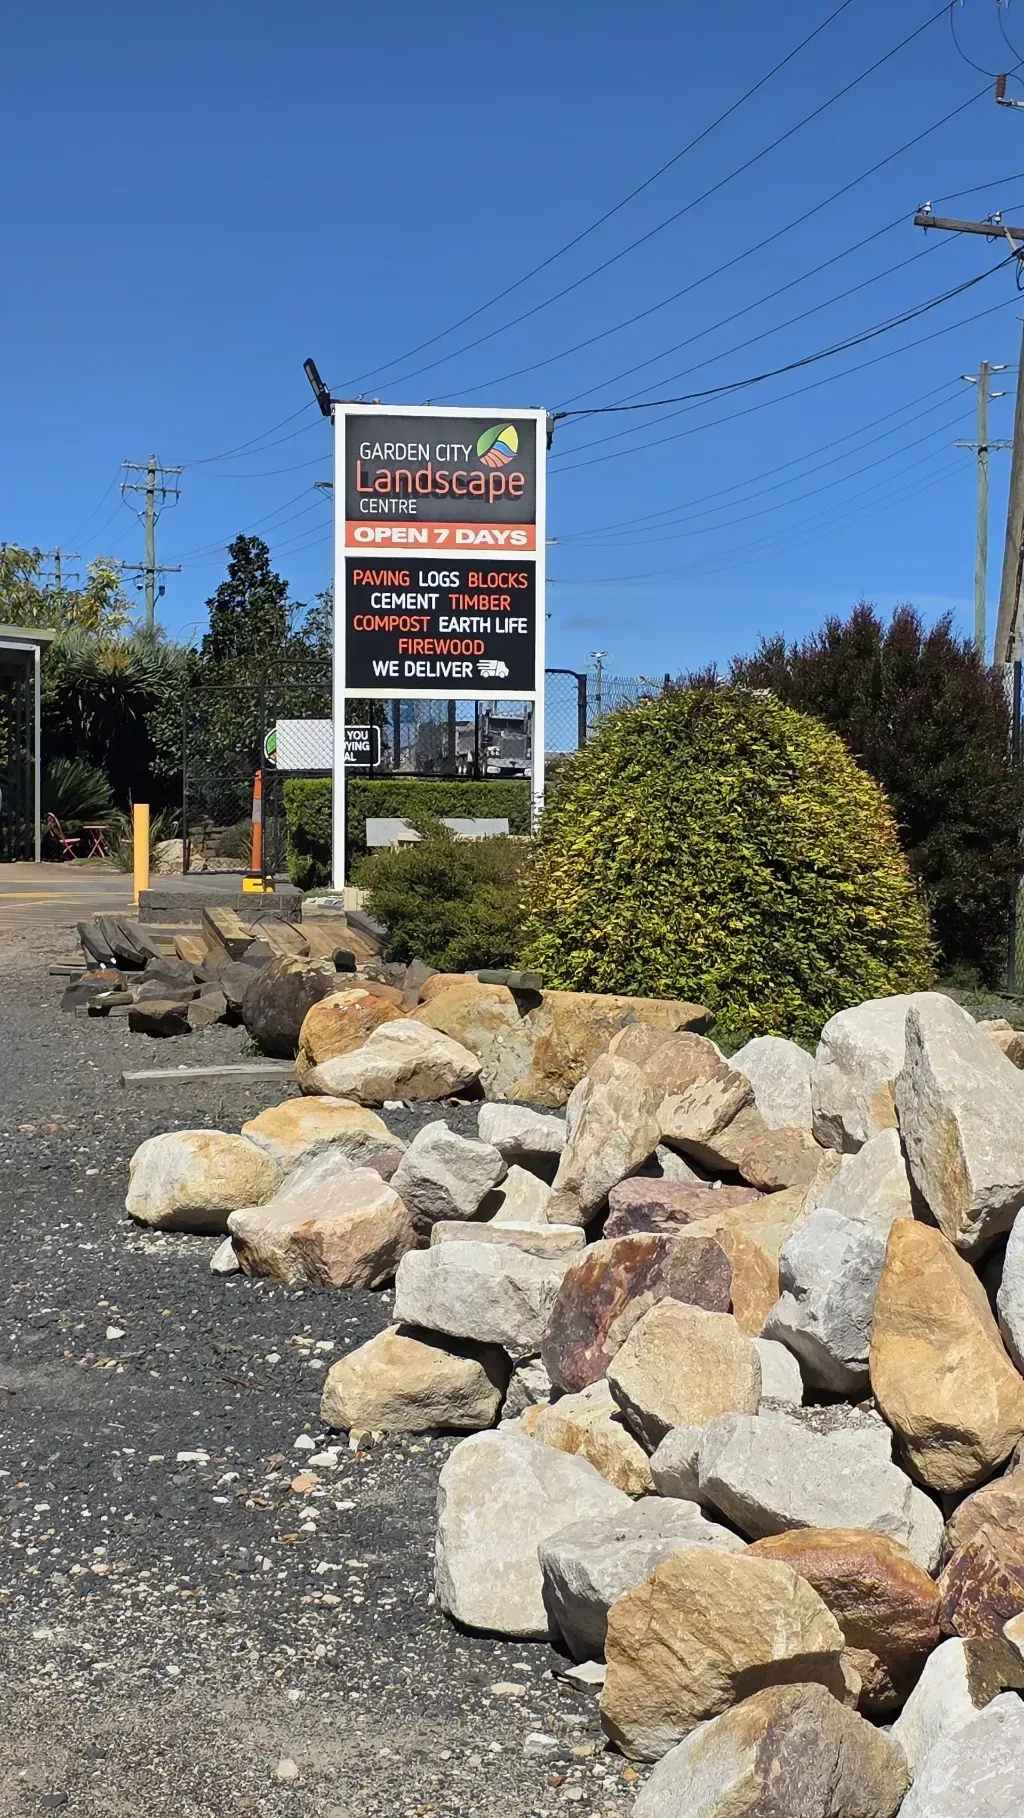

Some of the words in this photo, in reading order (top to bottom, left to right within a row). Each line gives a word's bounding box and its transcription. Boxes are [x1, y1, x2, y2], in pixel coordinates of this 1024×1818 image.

[359, 442, 430, 461] GARDEN
[435, 443, 473, 462] CITY
[356, 459, 525, 504] Landscape
[359, 498, 417, 514] CENTRE
[353, 526, 428, 544] OPEN
[433, 529, 449, 544] 7
[455, 530, 527, 545] DAYS
[353, 569, 410, 586] PAVING
[418, 571, 460, 587] LOGS
[468, 572, 528, 588] BLOCKS
[370, 592, 439, 609] CEMENT
[448, 594, 511, 611] TIMBER
[353, 615, 431, 632] COMPOST
[438, 617, 491, 633] EARTH
[495, 617, 528, 634] LIFE
[398, 638, 485, 655] FIREWOOD
[372, 660, 399, 677] WE
[404, 661, 473, 678] DELIVER
[347, 731, 368, 740] YOU
